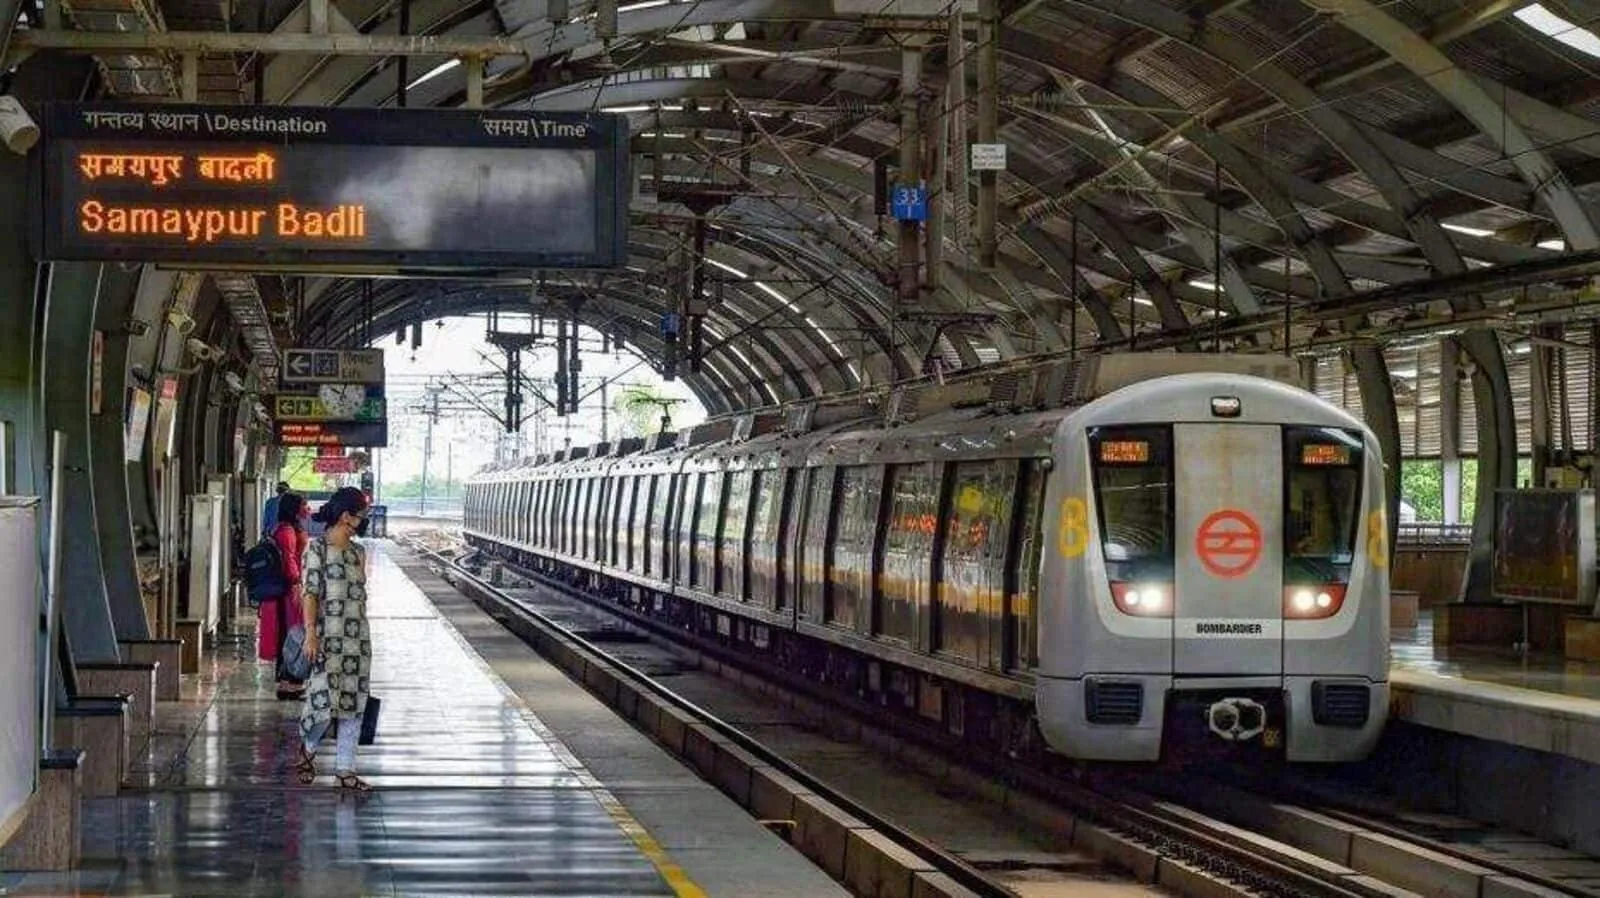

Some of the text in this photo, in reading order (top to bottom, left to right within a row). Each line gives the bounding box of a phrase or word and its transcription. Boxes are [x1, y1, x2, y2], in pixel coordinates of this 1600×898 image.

[83, 111, 144, 130] गन्तव्य
[149, 112, 199, 131] स्थान
[80, 153, 275, 185] समयपुर बादली
[81, 200, 365, 242] Samaypur Badli
[1060, 497, 1089, 559] 8
